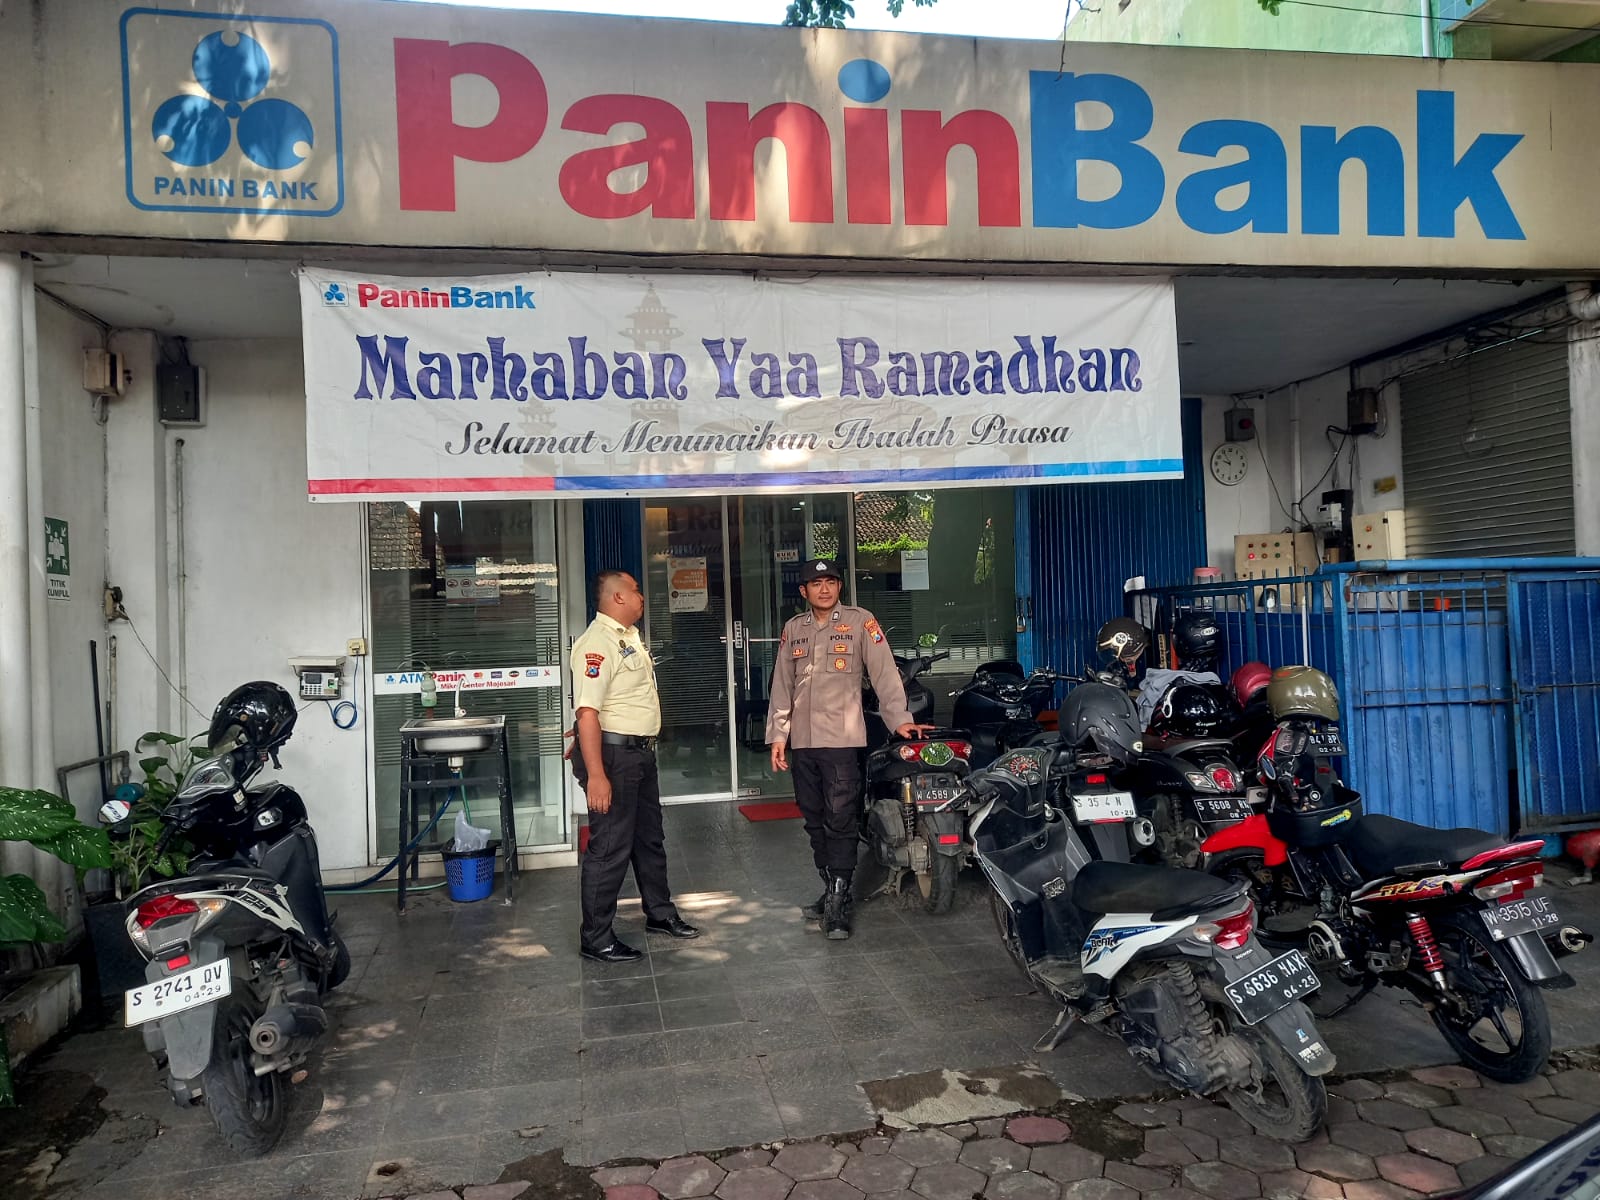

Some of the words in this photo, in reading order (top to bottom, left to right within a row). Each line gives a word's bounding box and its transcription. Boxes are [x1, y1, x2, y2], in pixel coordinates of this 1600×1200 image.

[393, 37, 1526, 241] PaninBank
[154, 176, 235, 198] PANIN
[242, 179, 319, 201] BANK
[357, 283, 536, 309] PaninBank
[355, 334, 688, 401] Marhaban
[701, 336, 822, 399] Yaa
[835, 334, 1143, 400] Ramadhan
[445, 420, 598, 456] Selamat
[600, 419, 822, 456] Menunaikan
[827, 415, 958, 451] Ibadah
[965, 413, 1074, 447] Puasa
[926, 789, 948, 800] 4589
[1197, 801, 1205, 811] S
[1484, 910, 1498, 925] W
[1499, 902, 1531, 922] 3515
[1531, 896, 1550, 913] UF
[132, 992, 143, 1007] S
[154, 975, 193, 1000] 2741
[1230, 988, 1244, 1004] S
[1244, 970, 1279, 997] 6636
